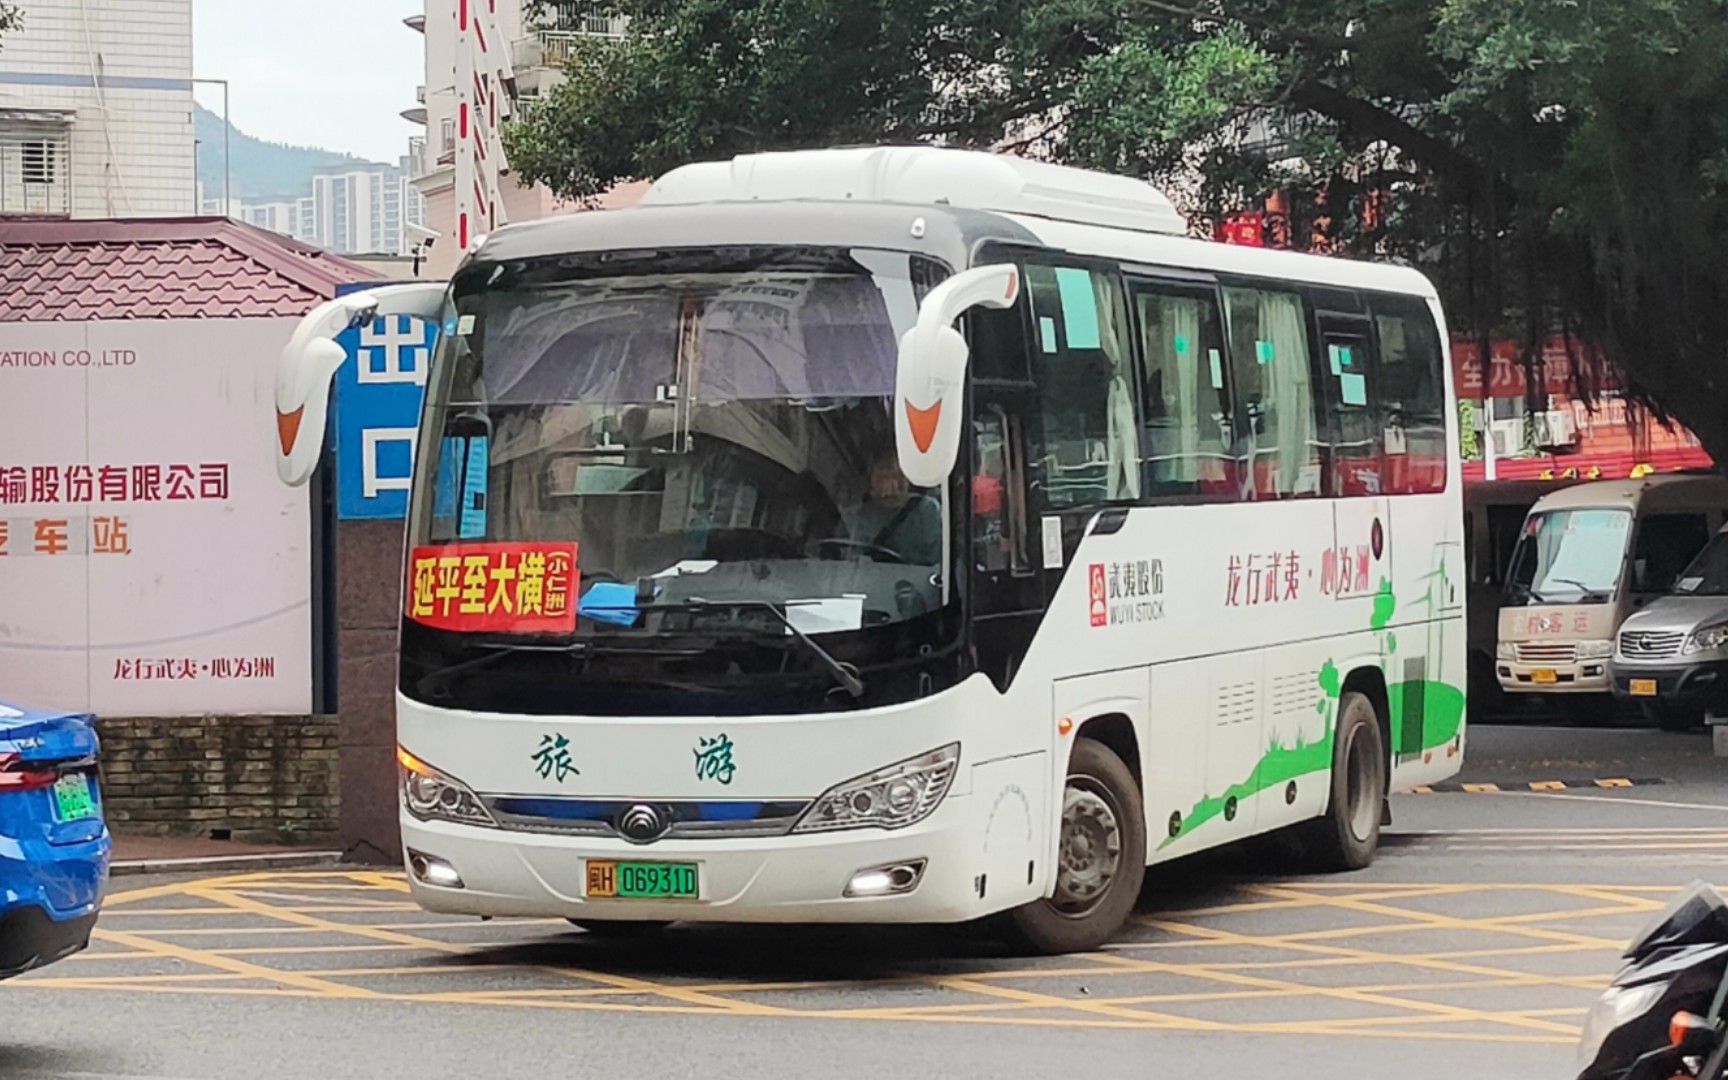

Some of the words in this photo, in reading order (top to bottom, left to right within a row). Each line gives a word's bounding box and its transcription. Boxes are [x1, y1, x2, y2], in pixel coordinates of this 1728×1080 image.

[357, 313, 428, 498] 出口
[0, 463, 229, 504] 输股份有限公司
[0, 516, 128, 556] 车站
[412, 551, 546, 618] 延平至大横
